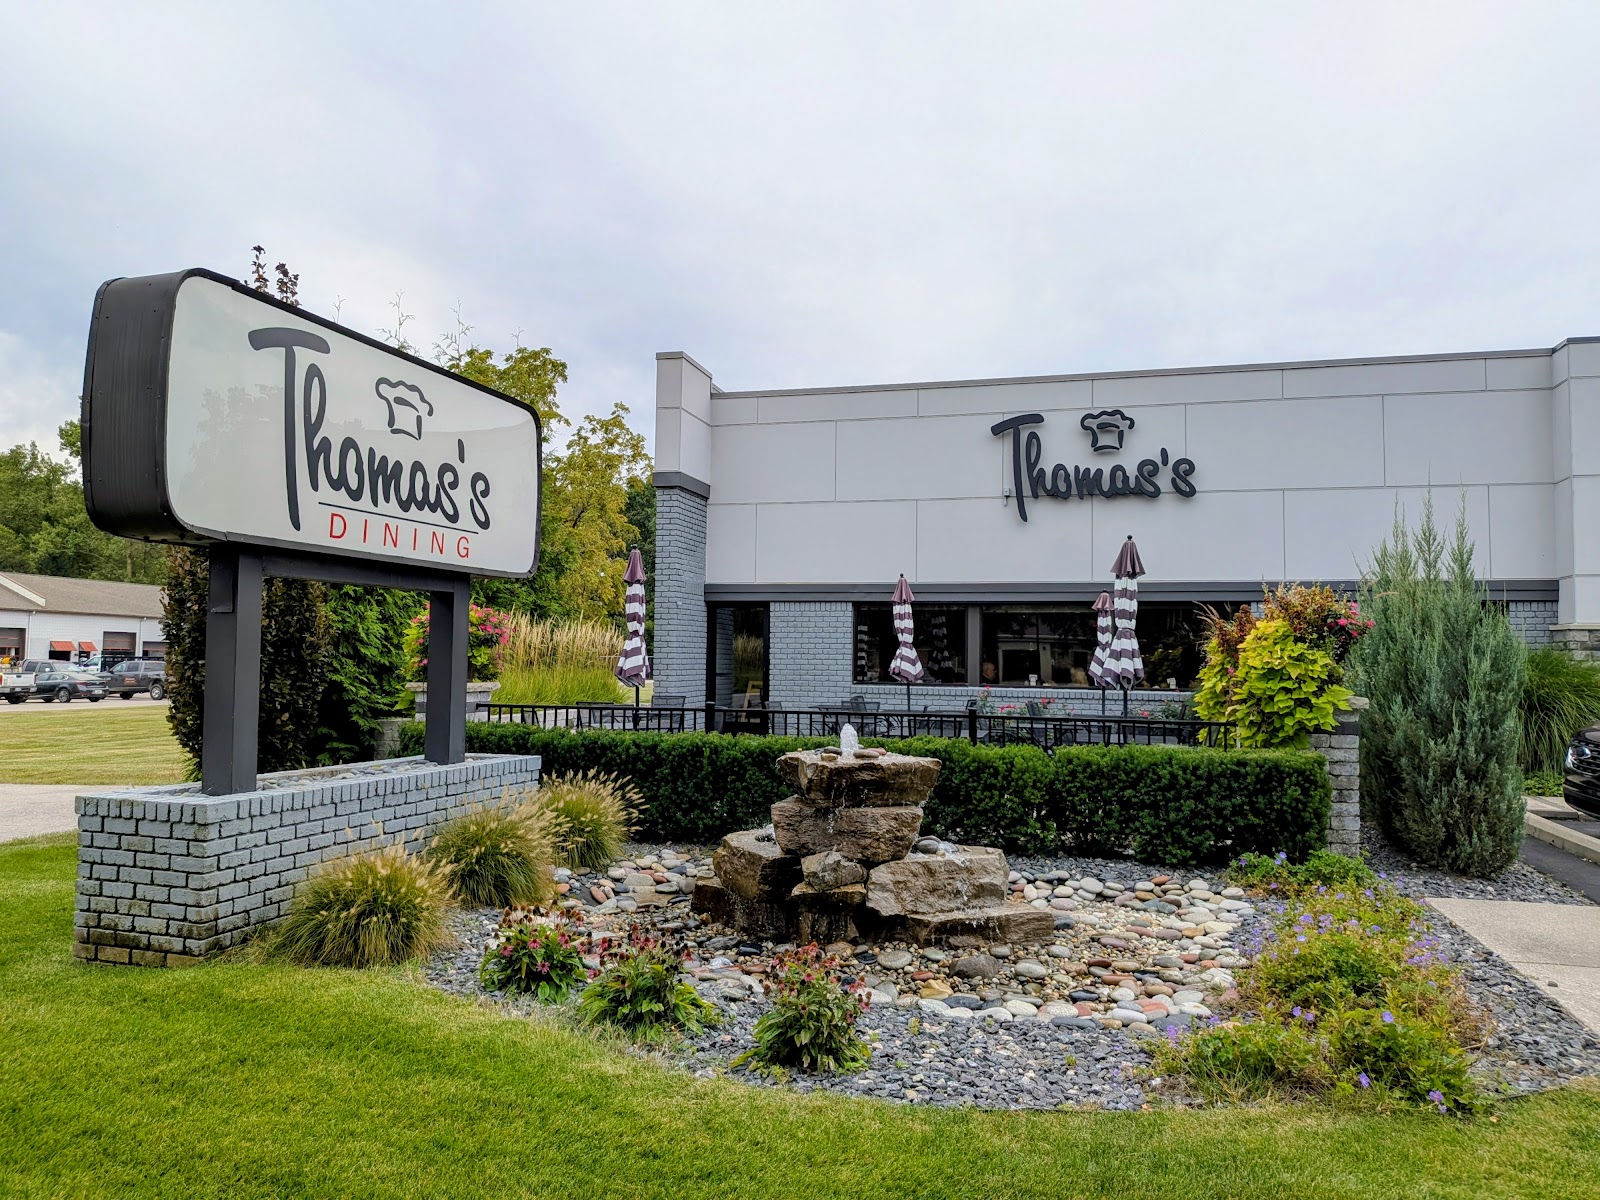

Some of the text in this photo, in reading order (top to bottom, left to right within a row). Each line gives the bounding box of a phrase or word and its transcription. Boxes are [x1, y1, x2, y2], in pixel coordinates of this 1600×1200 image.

[248, 327, 491, 531] Thomas's
[991, 413, 1196, 522] Thomas's
[329, 512, 470, 559] DINING
